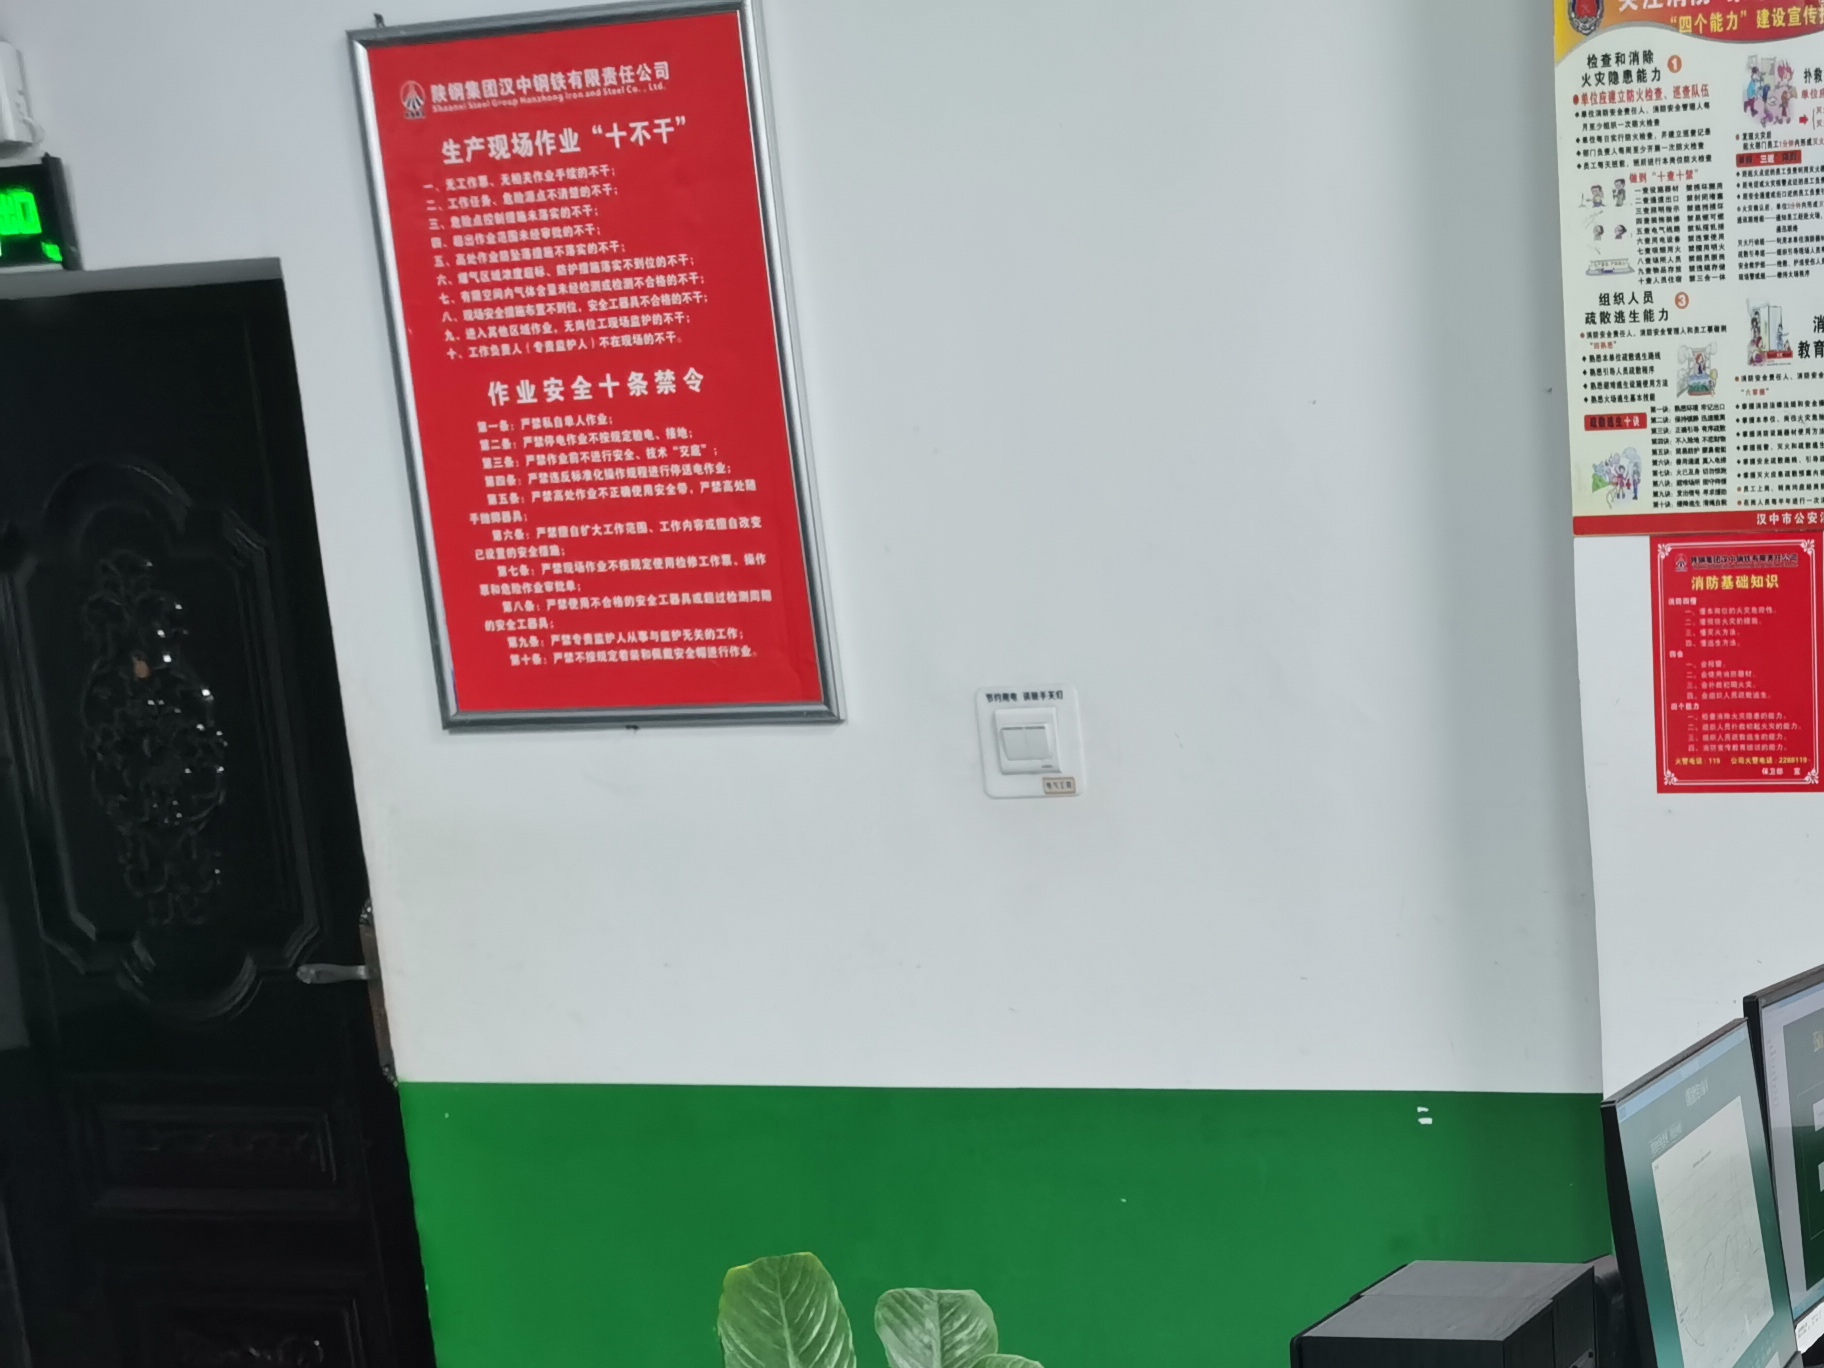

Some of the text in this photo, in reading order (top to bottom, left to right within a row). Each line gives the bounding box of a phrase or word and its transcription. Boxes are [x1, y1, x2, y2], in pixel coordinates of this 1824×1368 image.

[1587, 49, 1654, 69] 检查和消除
[430, 62, 670, 103] 陕钢集团汉中钢铁有限责任公司
[1581, 67, 1661, 88] 火灾隐患能力
[603, 87, 625, 96] Steel
[1599, 291, 1654, 306] 组织人员
[1585, 308, 1669, 325] 疏散逃生能力
[488, 368, 705, 406] 作业安全十条禁令
[1691, 574, 1779, 590] 消防基础知识
